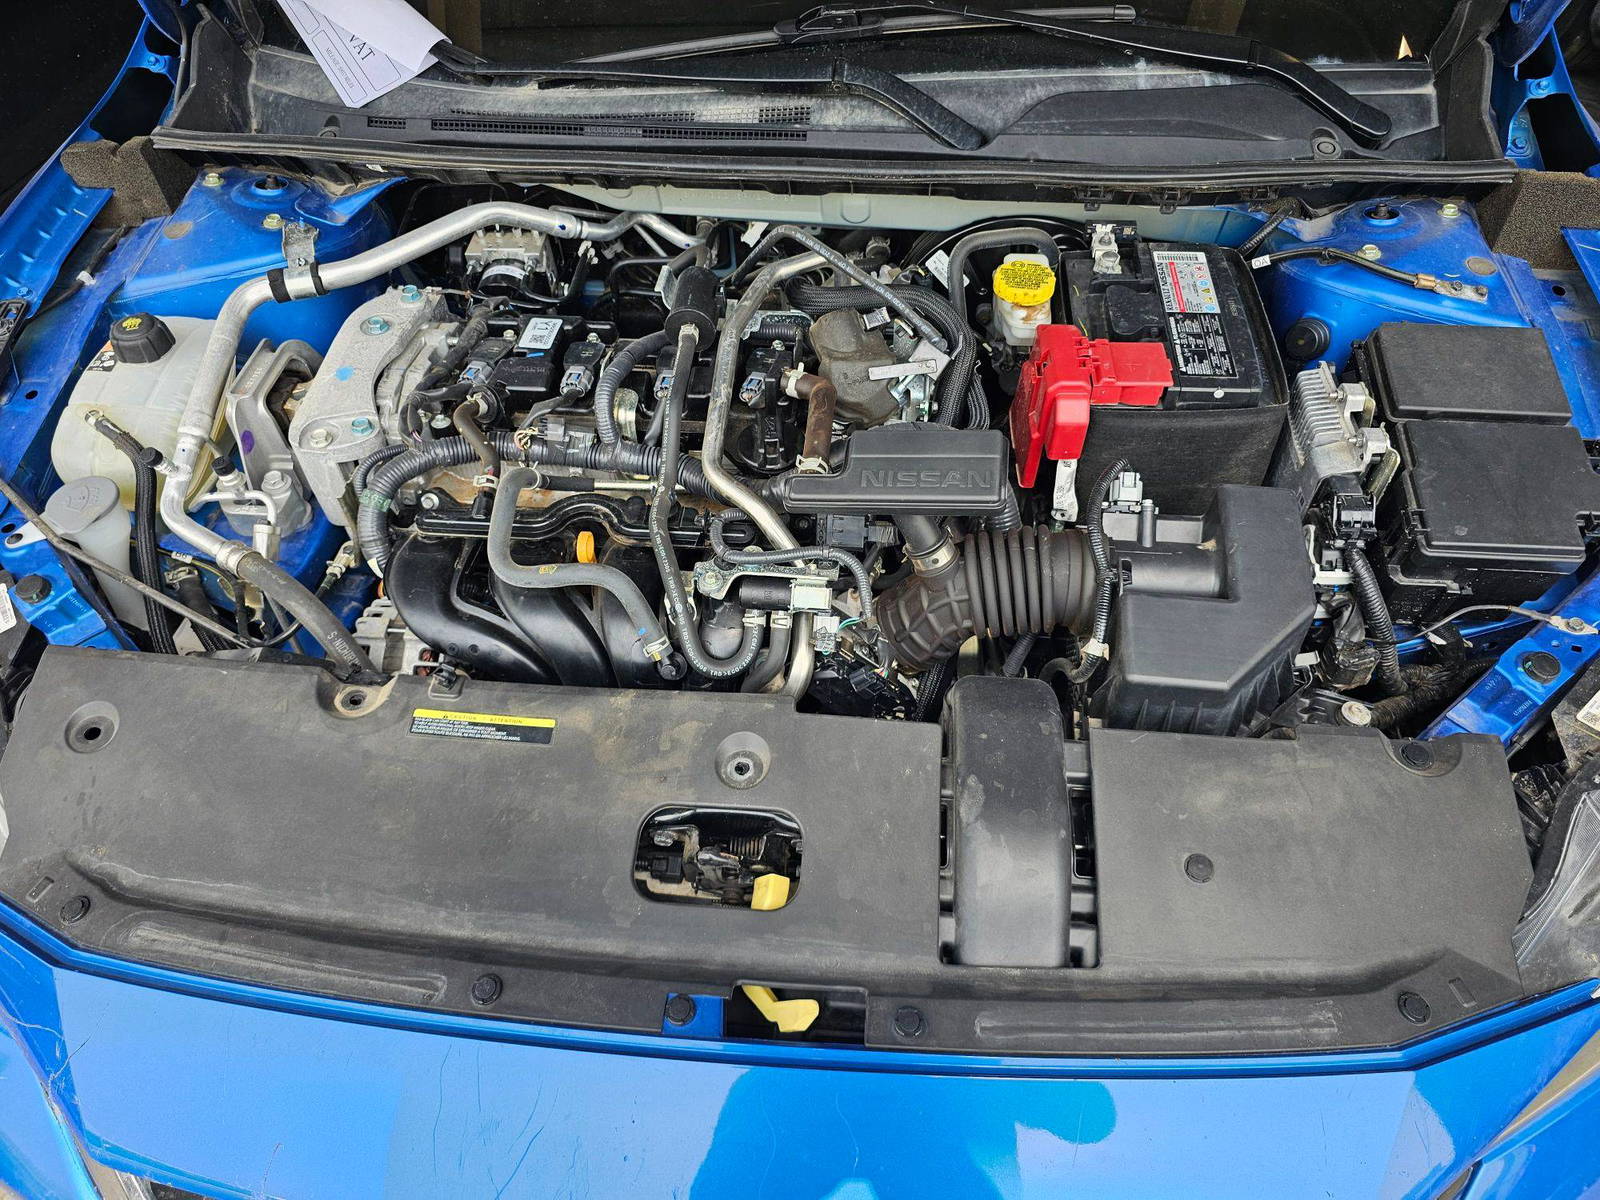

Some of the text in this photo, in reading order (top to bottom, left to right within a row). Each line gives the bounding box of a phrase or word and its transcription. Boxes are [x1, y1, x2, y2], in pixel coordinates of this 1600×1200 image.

[349, 34, 376, 61] VAT
[1157, 262, 1169, 287] NISSAN
[861, 470, 991, 488] NISSAN
